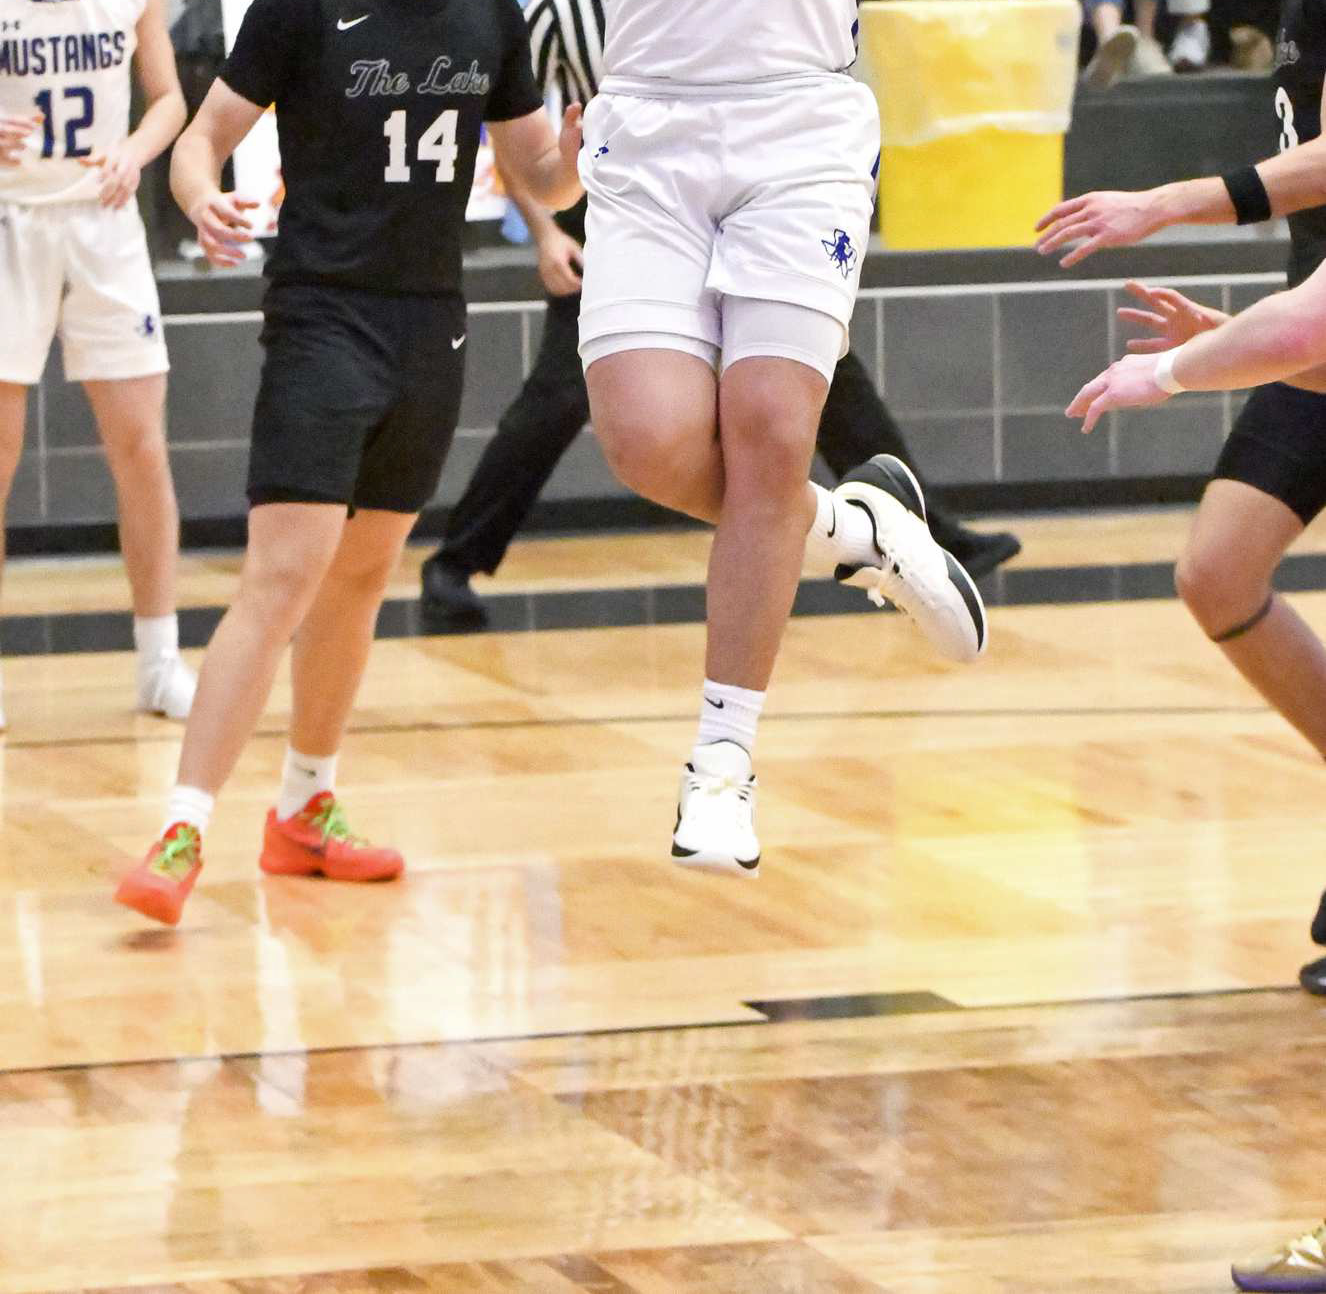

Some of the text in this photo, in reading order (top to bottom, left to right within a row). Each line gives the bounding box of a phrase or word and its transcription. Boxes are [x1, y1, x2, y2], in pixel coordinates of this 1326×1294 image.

[0, 30, 126, 77] MUSTANGS
[345, 56, 490, 98] The Lake
[35, 86, 95, 159] 12
[383, 109, 459, 183] 14
